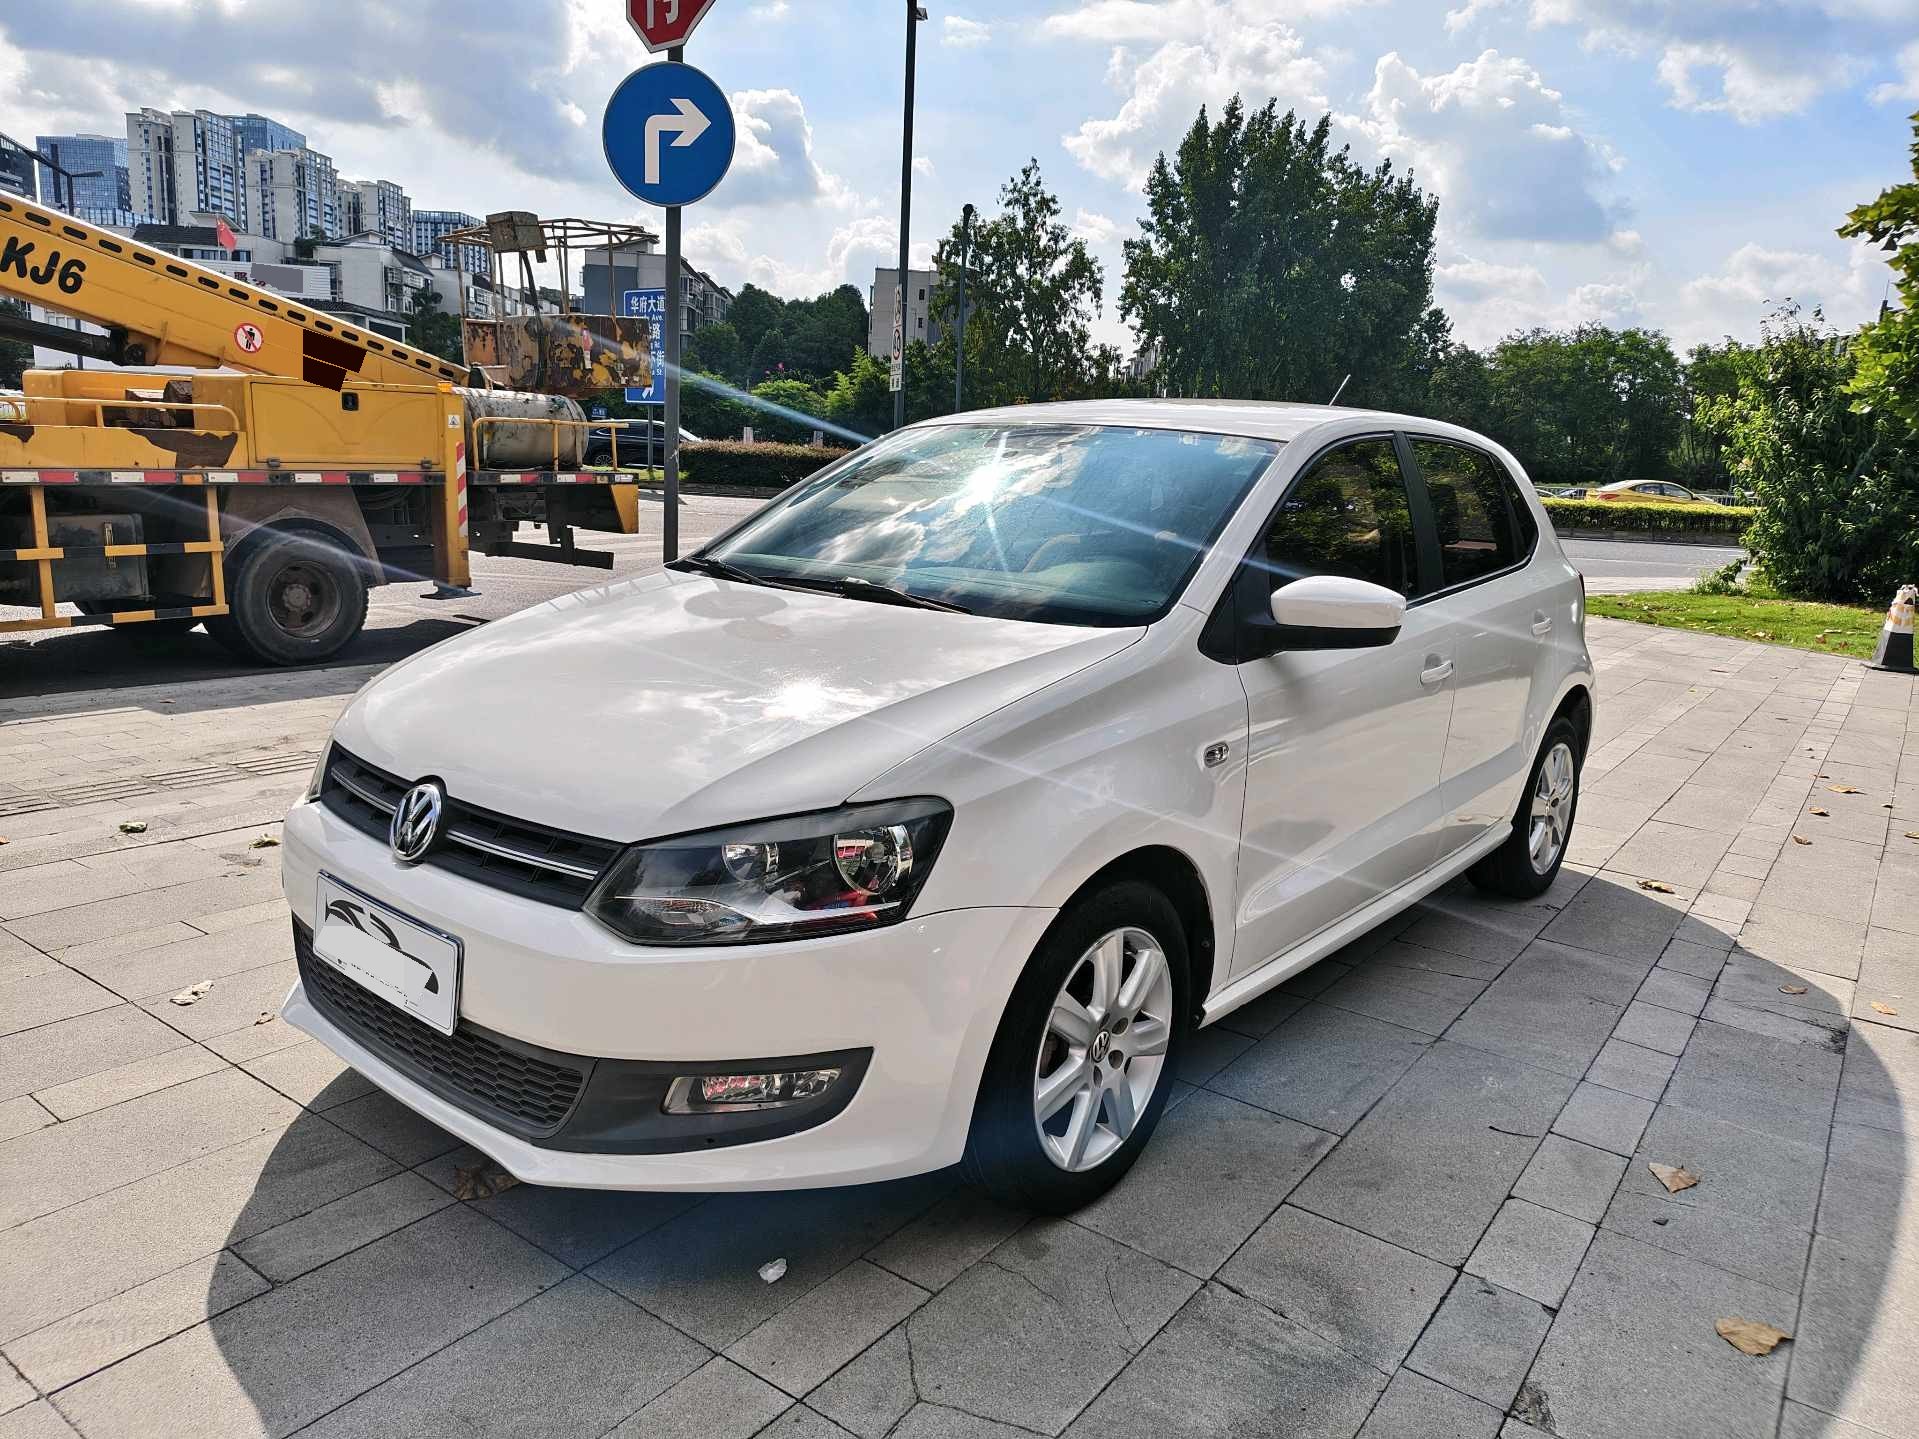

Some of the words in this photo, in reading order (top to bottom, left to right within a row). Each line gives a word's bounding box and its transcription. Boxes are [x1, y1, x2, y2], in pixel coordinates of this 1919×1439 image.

[0, 236, 86, 294] KJ6
[631, 295, 666, 313] 华府大道
